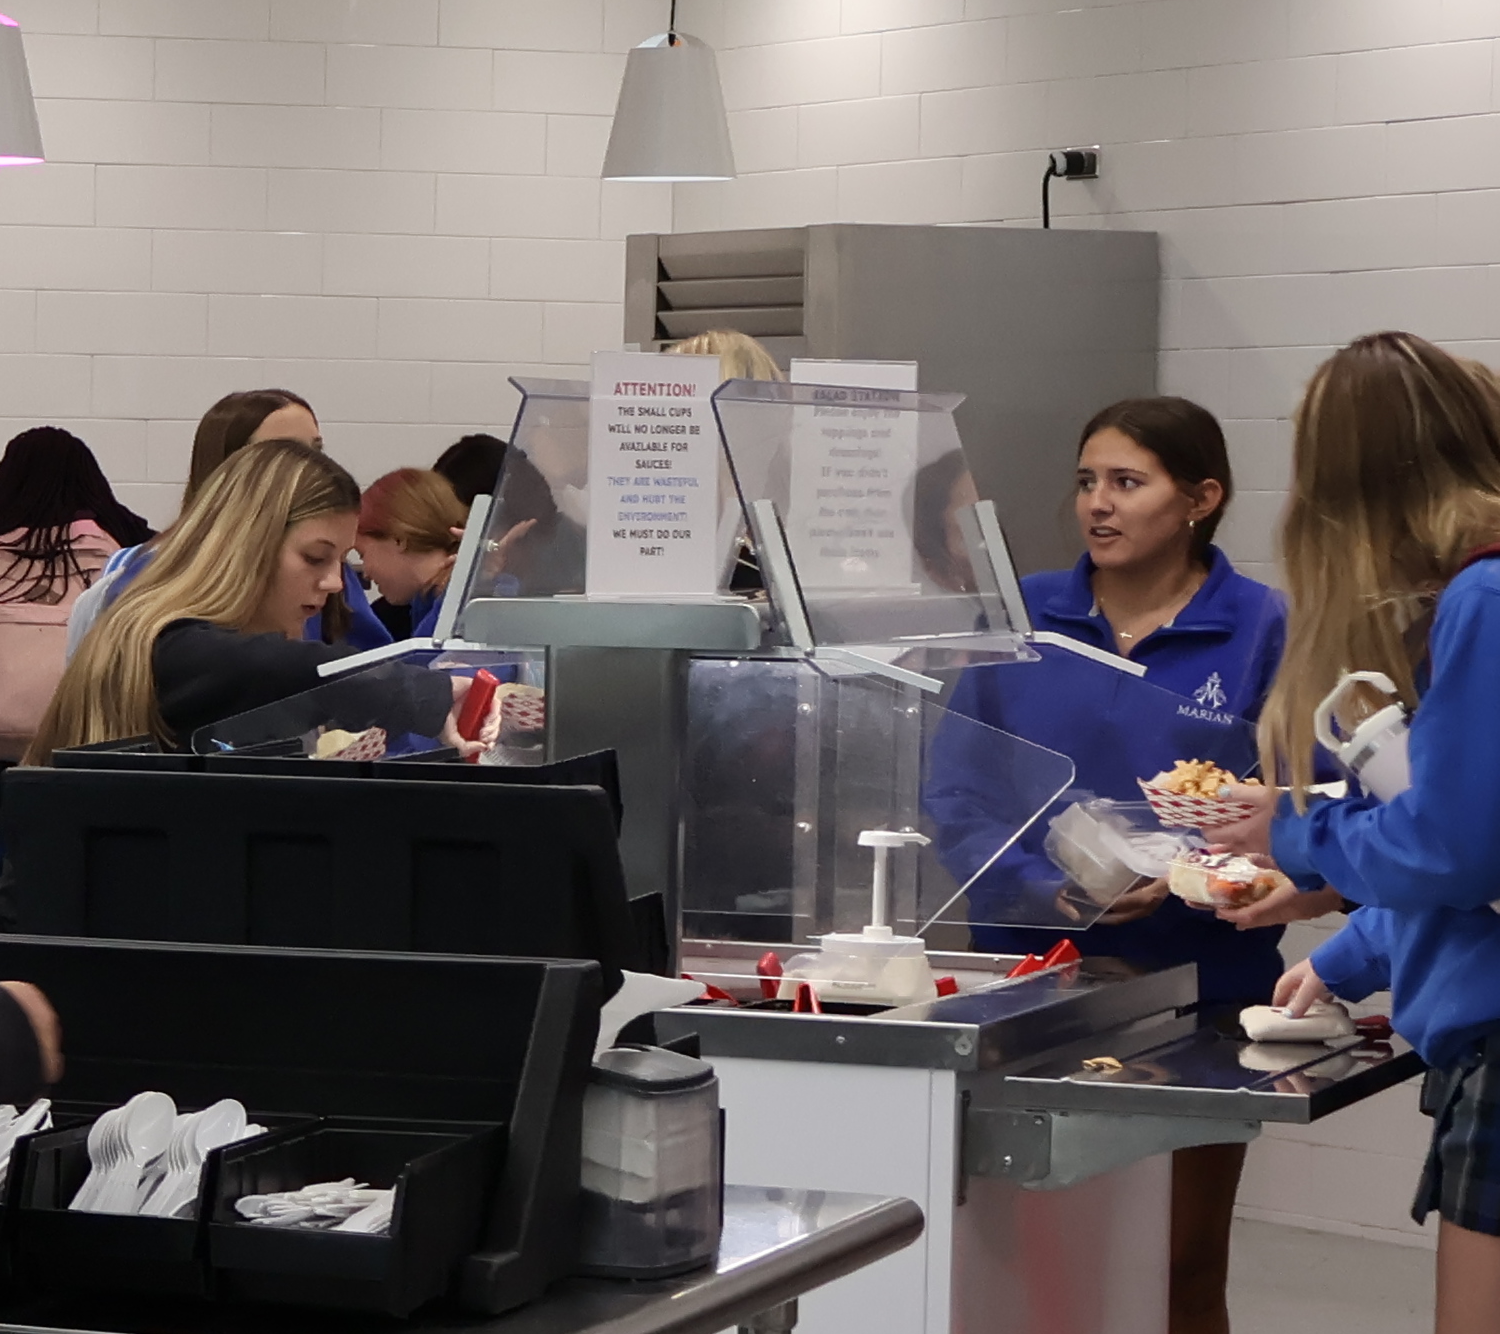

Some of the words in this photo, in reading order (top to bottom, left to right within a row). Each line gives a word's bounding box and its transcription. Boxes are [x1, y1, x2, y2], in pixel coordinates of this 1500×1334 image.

[613, 382, 696, 397] ATTENTION!
[618, 407, 635, 417] THE
[638, 407, 666, 417] SMALL
[669, 407, 692, 417] CUPS
[608, 424, 631, 434] WILL
[634, 424, 648, 434] NO
[650, 424, 687, 435] LONGER
[689, 425, 700, 435] BE
[619, 442, 668, 452] AVAILABLE
[671, 442, 688, 452] FOR
[635, 459, 672, 470] SAUCES!
[620, 494, 639, 504] AND
[668, 495, 686, 504] THE
[612, 529, 627, 539] WE
[629, 529, 654, 539] MUST
[657, 529, 670, 539] DO
[672, 530, 691, 539] OUR
[639, 547, 665, 556] PART!
[1176, 704, 1235, 725] MARIAN
